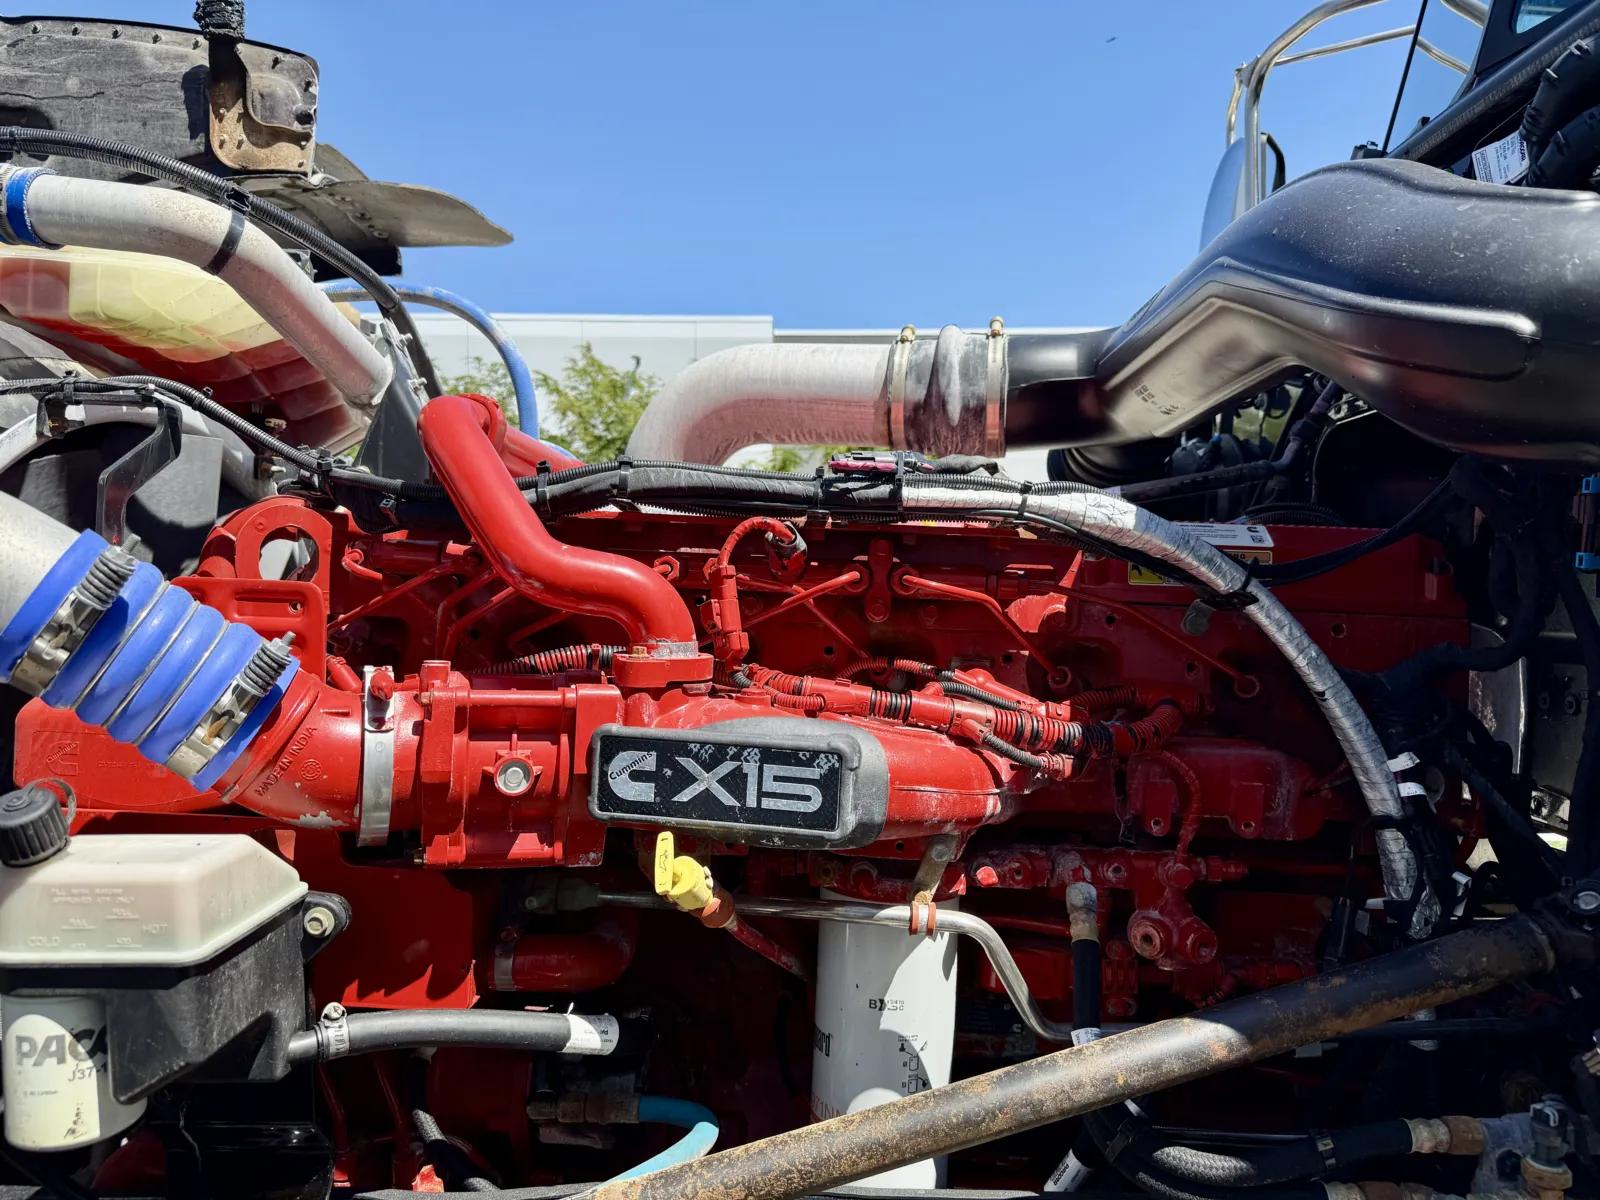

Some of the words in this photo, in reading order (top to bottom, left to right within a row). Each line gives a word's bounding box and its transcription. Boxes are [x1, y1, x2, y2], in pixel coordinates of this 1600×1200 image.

[254, 767, 284, 797] MADE
[279, 755, 293, 771] IN
[290, 726, 317, 757] INDIA
[609, 751, 653, 780] Cummins
[671, 756, 823, 813] X15
